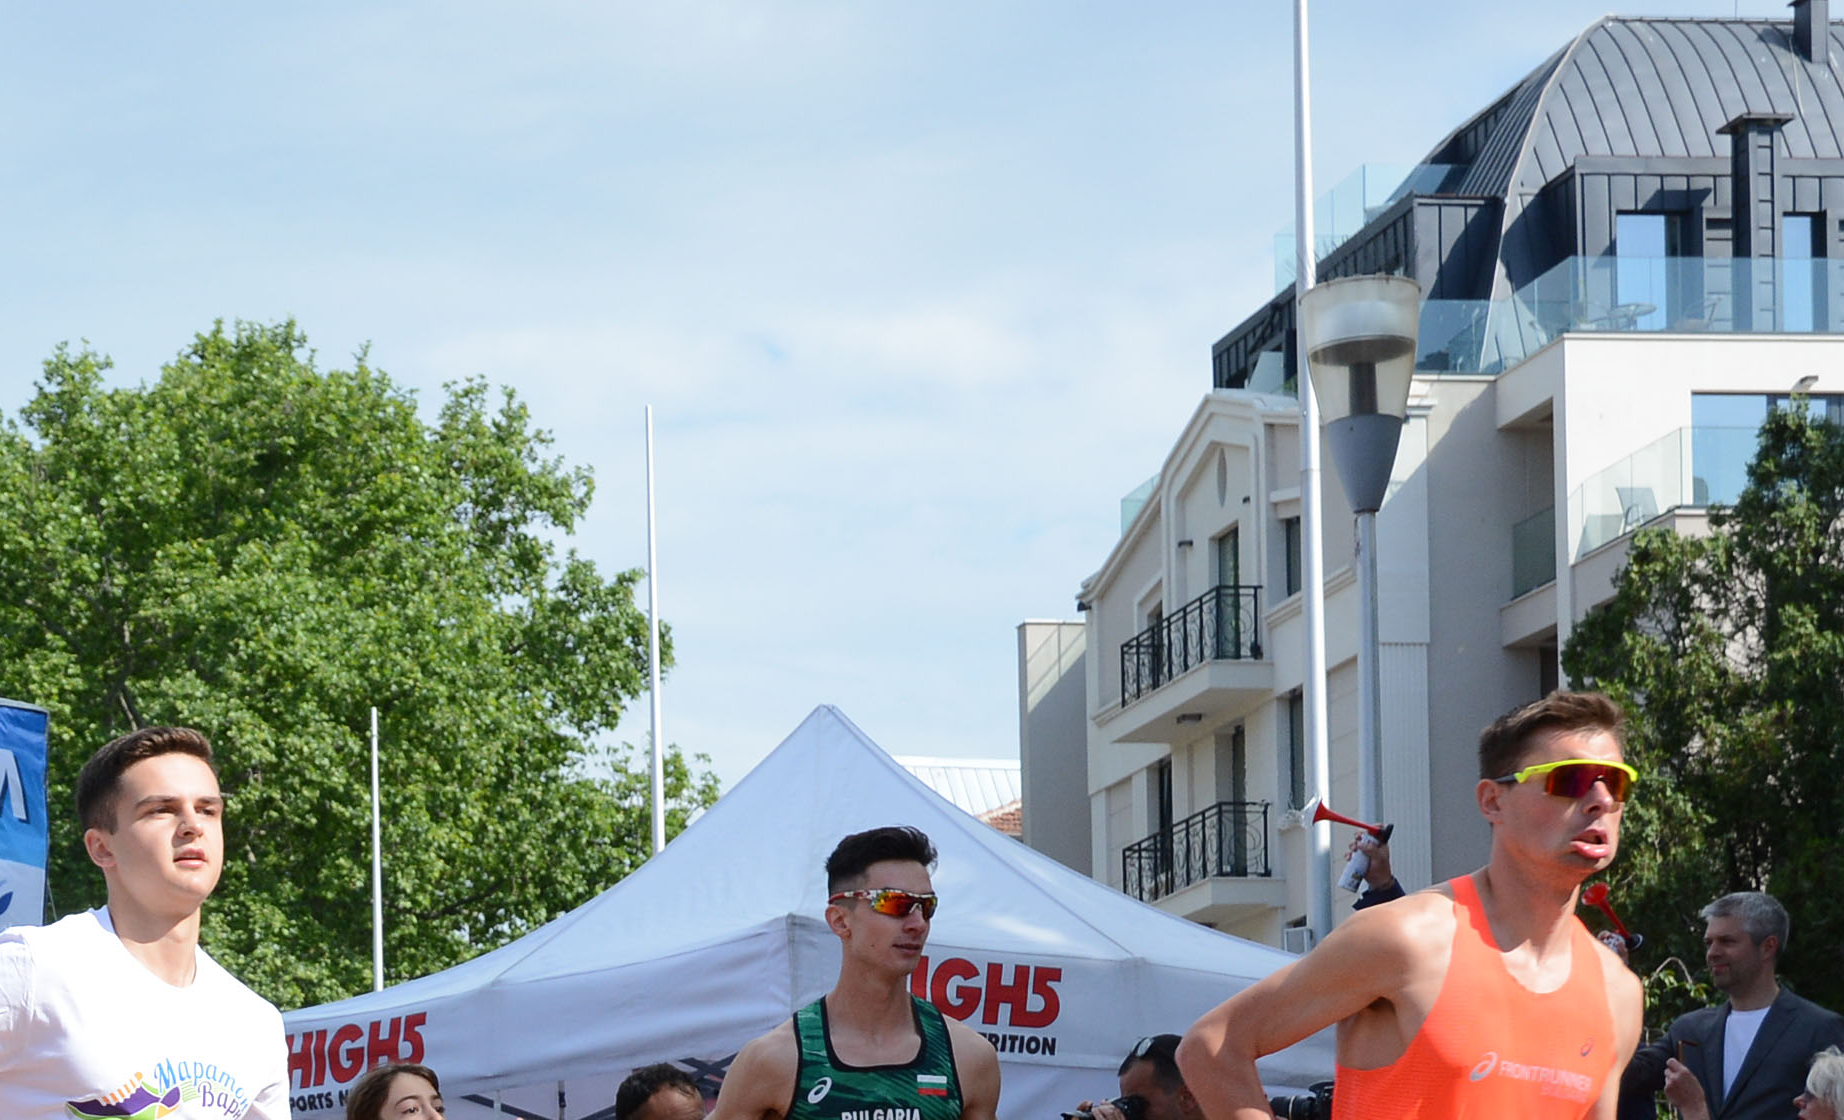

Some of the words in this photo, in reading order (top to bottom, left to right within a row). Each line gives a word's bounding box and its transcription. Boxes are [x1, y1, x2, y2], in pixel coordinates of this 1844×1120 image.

[910, 955, 1062, 1029] IGH5
[286, 1011, 427, 1089] HIGH5
[290, 1091, 334, 1113] PORTS
